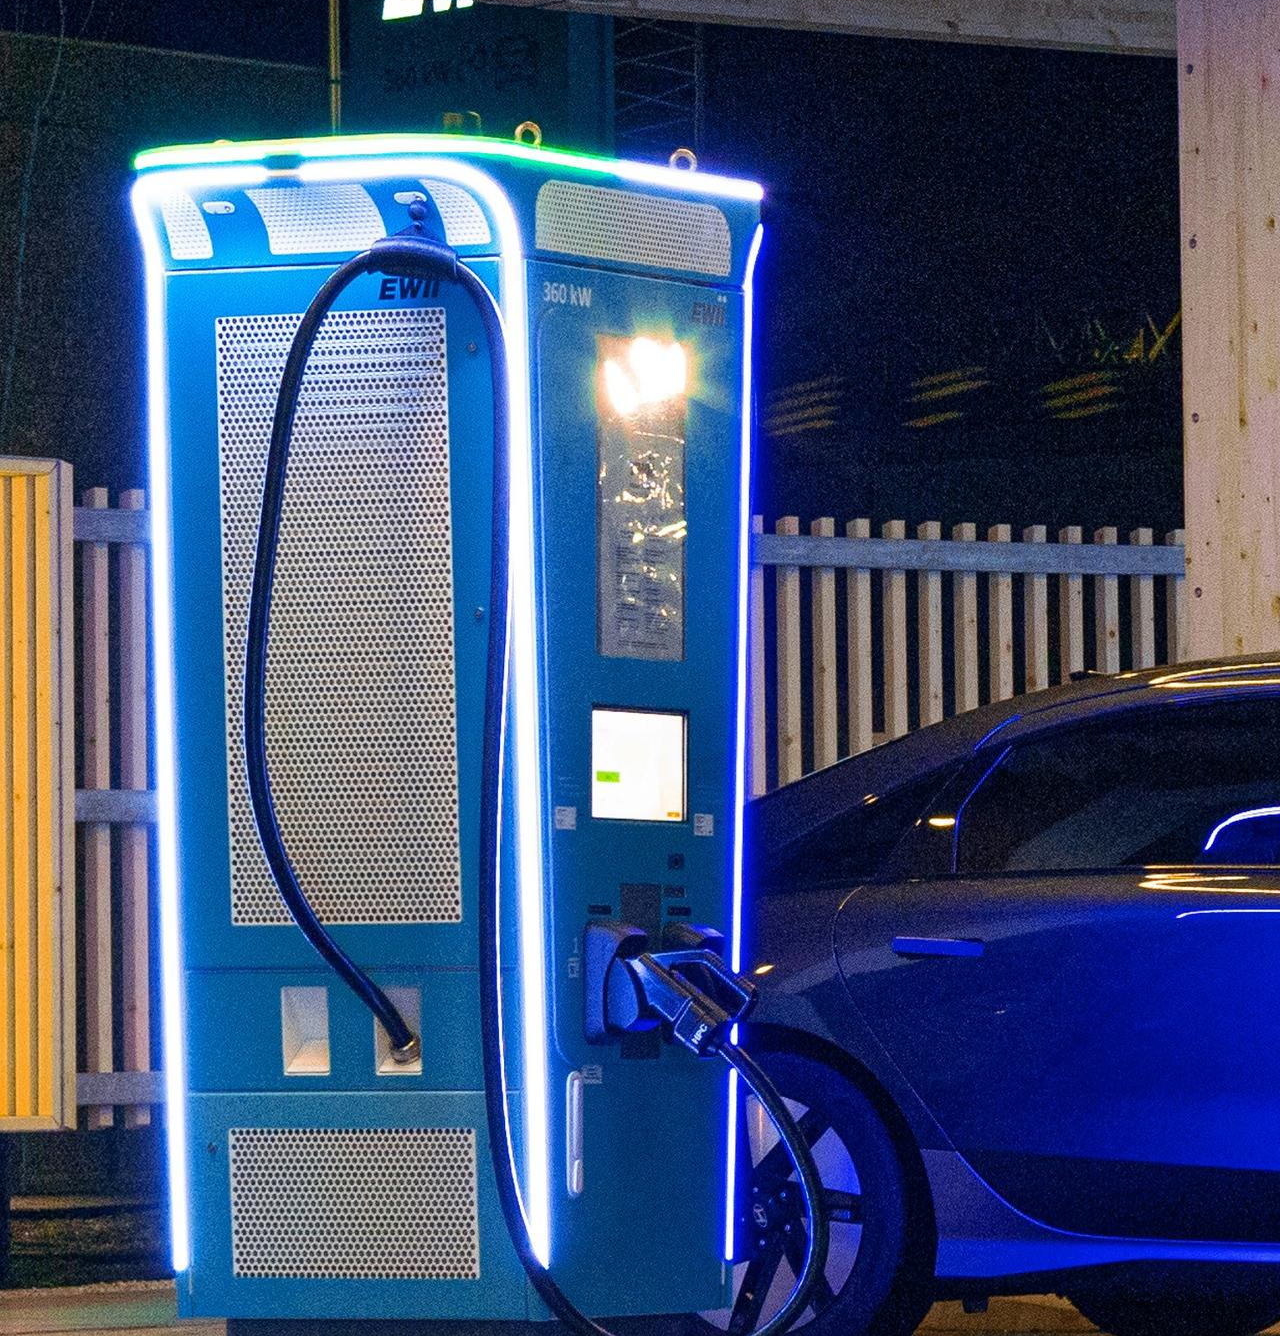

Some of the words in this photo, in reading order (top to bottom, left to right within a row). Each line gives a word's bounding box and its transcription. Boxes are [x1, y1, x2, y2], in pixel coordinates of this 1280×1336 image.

[543, 281, 568, 304] 360
[570, 283, 592, 308] kW
[691, 1023, 708, 1045] HPC
